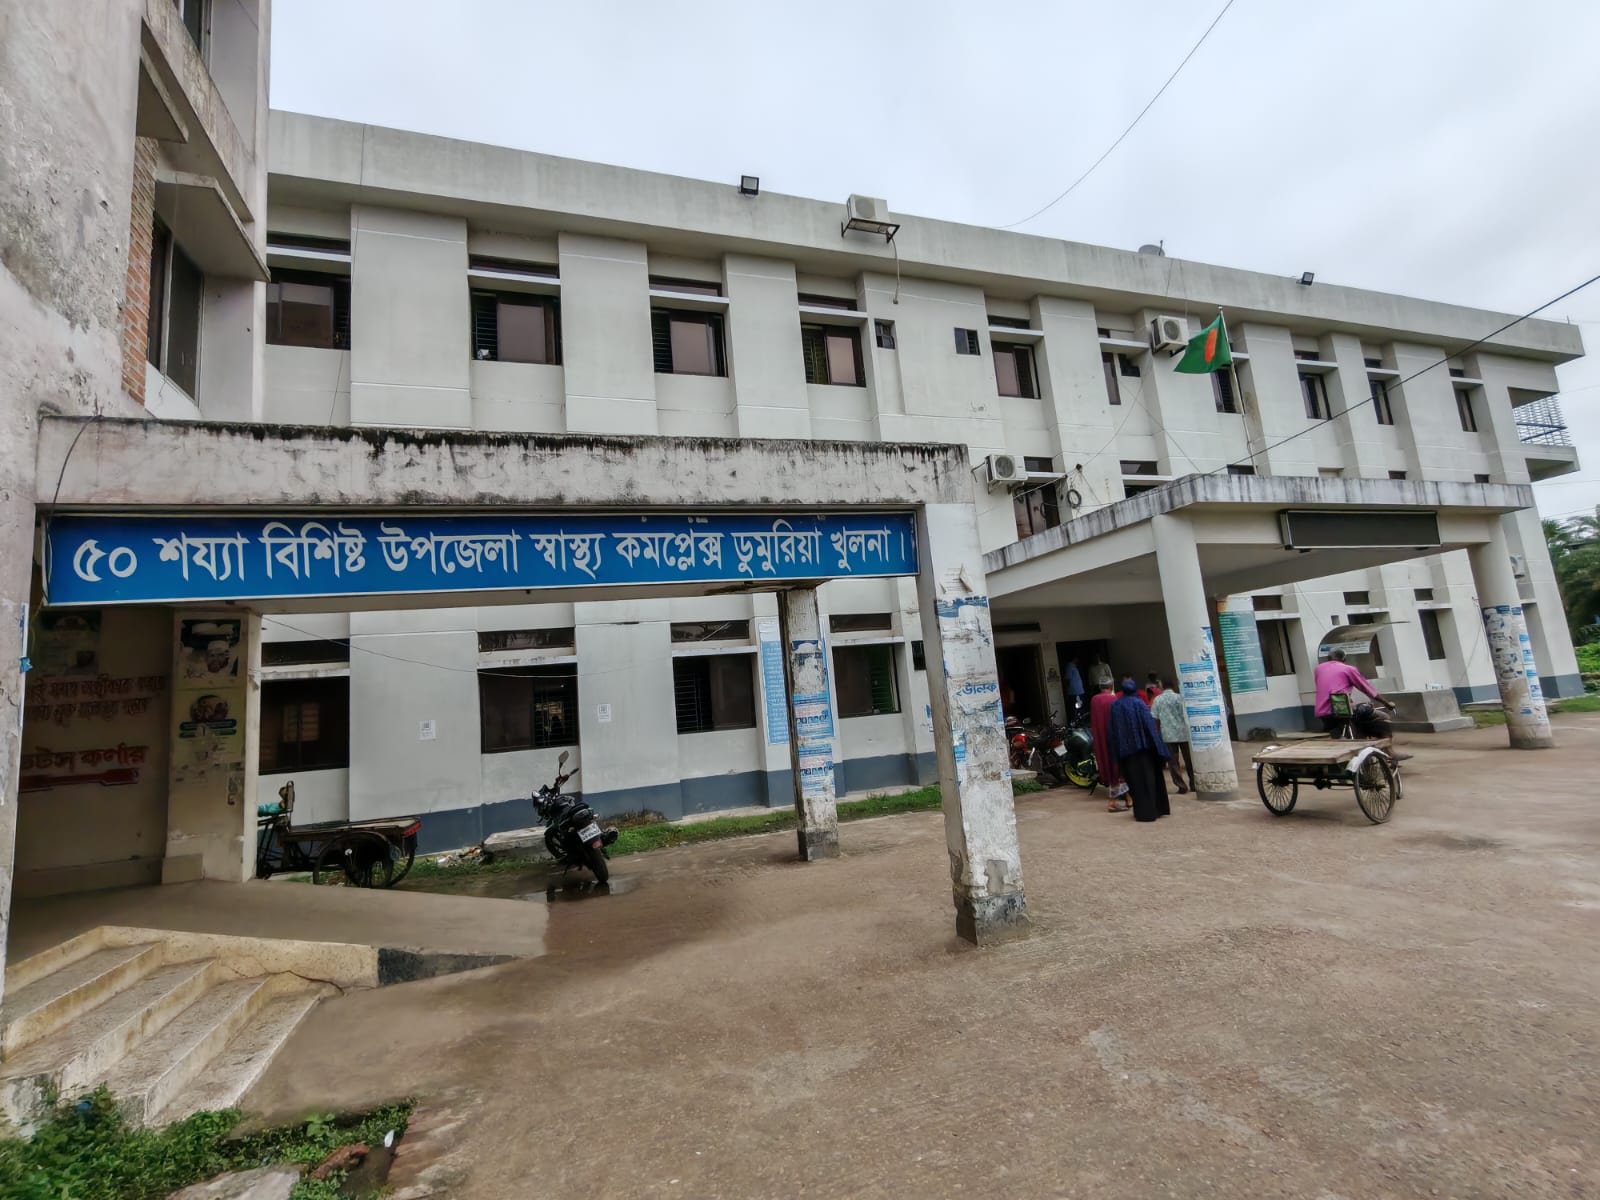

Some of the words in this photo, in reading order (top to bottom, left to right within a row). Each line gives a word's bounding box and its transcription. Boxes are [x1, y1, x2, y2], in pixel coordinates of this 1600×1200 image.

[73, 539, 138, 582] ৫০
[152, 531, 250, 581] শয্যা
[258, 521, 367, 580] বিশিষ্ট
[376, 521, 522, 576] উপজেলা
[529, 528, 606, 580] স্বাস্থ্য
[612, 528, 725, 571] কমপ্লেক্স
[730, 518, 823, 577] ডুমুরিয়া
